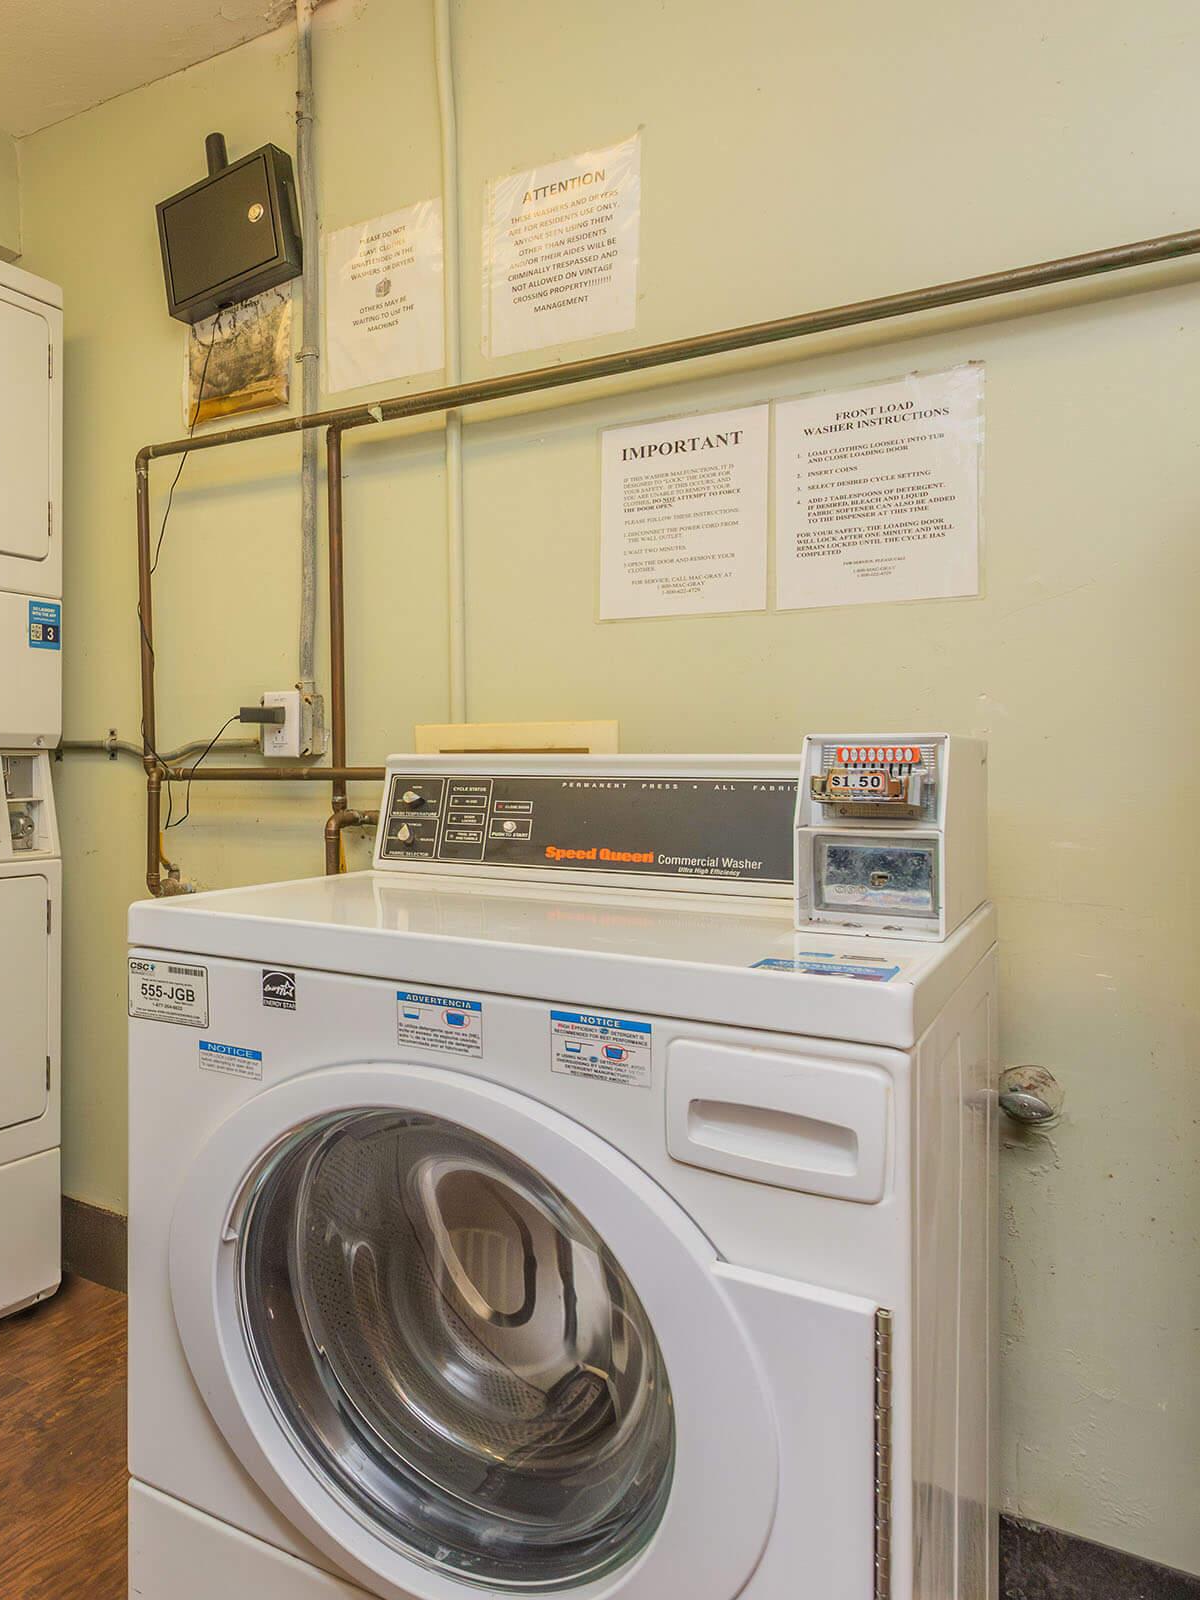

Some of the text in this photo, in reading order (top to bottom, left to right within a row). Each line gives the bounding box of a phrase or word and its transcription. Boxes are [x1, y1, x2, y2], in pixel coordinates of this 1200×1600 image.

[522, 168, 605, 204] ATTENTION
[534, 204, 568, 217] WASHERS
[565, 220, 588, 232] USING
[590, 214, 613, 225] THEM
[518, 245, 542, 256] OTHER
[540, 251, 561, 262] THEIR
[562, 245, 585, 256] AIDES
[586, 240, 605, 250] WILL
[606, 237, 616, 246] BE
[507, 249, 617, 281] CRIMINALLY TRESPASSED AND
[511, 262, 613, 292] NOT ALLOWED ON VINTAGE
[512, 289, 548, 304] CROSSING
[533, 295, 588, 312] MANAGEMENT
[836, 401, 913, 420] FRONT LOAD
[803, 407, 949, 435] WASHER INSTRUCTIONS
[622, 430, 743, 460] IMPORTANT
[829, 444, 868, 454] CLOTHING
[870, 438, 905, 448] LOOSELY
[907, 435, 927, 443] INTO
[824, 453, 848, 461] CLOSE
[849, 449, 884, 458] LOADING
[886, 445, 908, 453] DOOR
[807, 468, 833, 477] INSERT
[836, 478, 868, 486] DESIRED
[897, 470, 930, 478] SETTING
[830, 490, 882, 501] TABLESPOONS
[47, 627, 54, 640] 3
[832, 776, 880, 787] $1.50
[545, 846, 762, 870] Speed Queen Commercial Washer
[130, 962, 149, 971] CSC
[141, 983, 195, 1002] 555-JGB
[406, 994, 471, 1008] ADVERTENCIA
[580, 1015, 620, 1027] NOTICE
[207, 1044, 253, 1058] NOTICE
